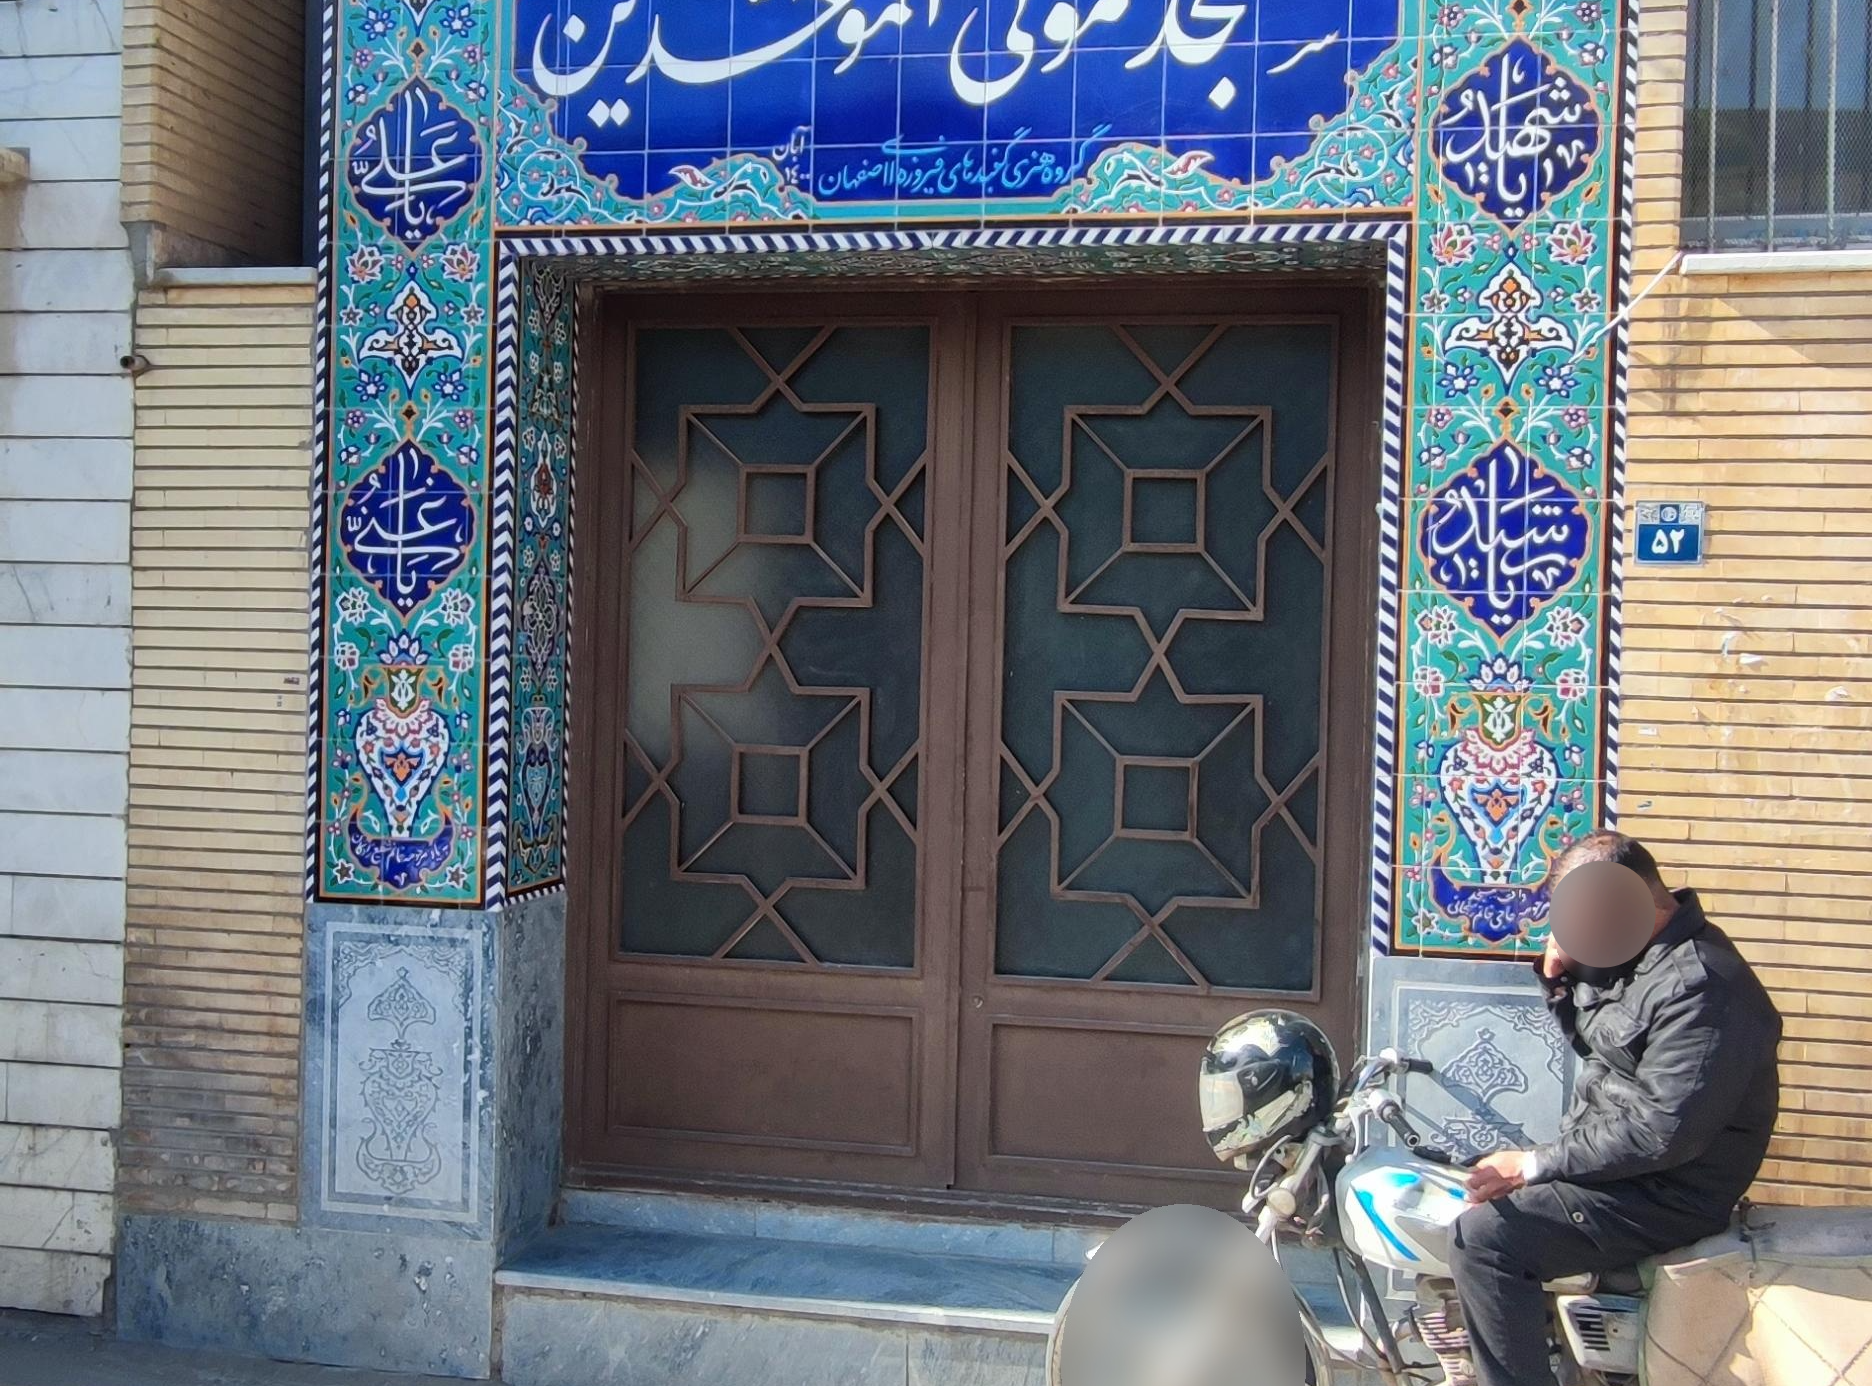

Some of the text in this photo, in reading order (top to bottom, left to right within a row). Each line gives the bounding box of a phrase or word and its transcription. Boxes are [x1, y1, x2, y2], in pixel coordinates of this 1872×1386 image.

[1001, 149, 1057, 190] هنری
[1041, 123, 1113, 185] گروه
[1651, 528, 1685, 554] ۵۲
